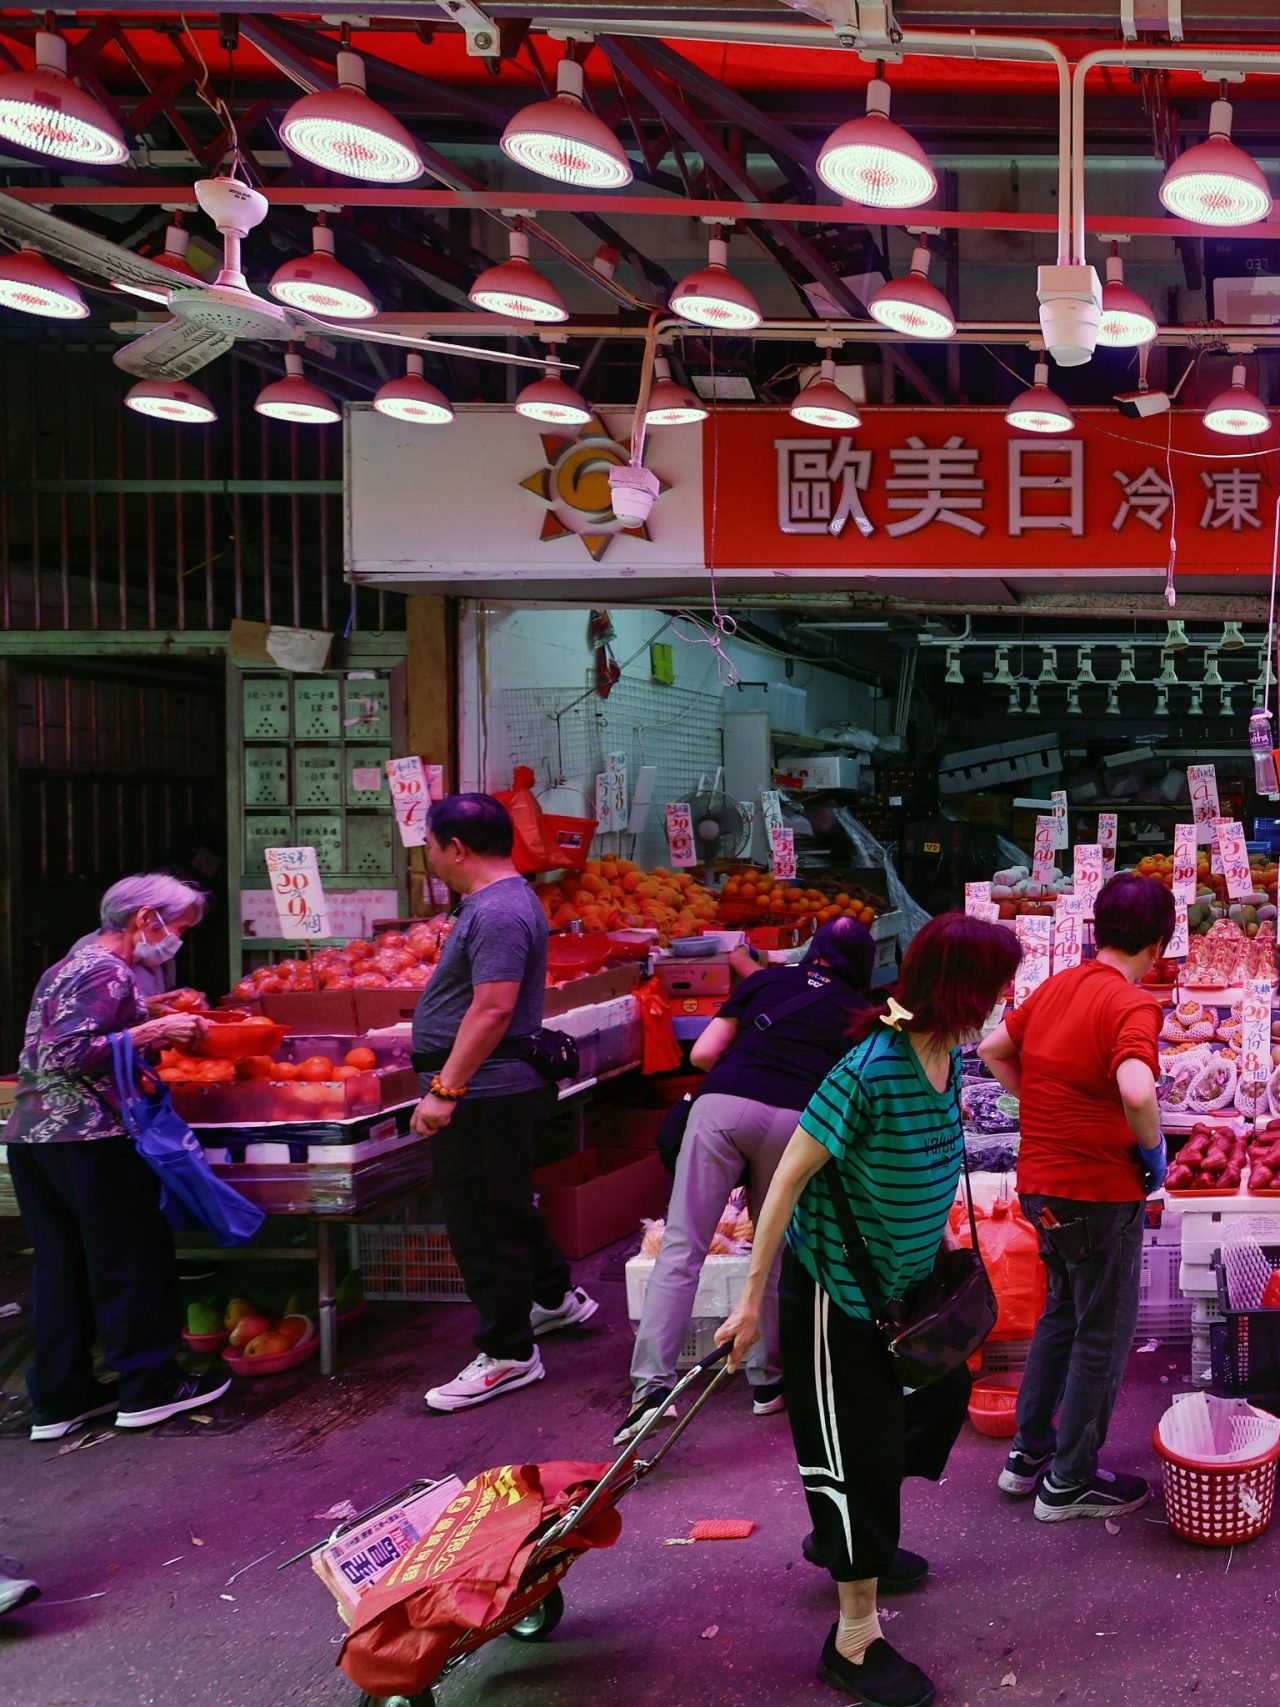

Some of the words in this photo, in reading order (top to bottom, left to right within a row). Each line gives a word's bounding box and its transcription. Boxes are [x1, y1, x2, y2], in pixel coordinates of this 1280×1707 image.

[774, 436, 1085, 538] 歐美日
[393, 779, 421, 800] 20
[1193, 784, 1213, 801] 4
[403, 801, 422, 827] 7
[669, 818, 689, 832] 20
[1174, 843, 1190, 860] 4
[1224, 841, 1240, 862] 2
[276, 872, 309, 894] 20
[1076, 870, 1099, 885] 20
[1174, 867, 1195, 882] 50
[288, 896, 307, 928] 9
[1057, 917, 1076, 938] 4
[1055, 942, 1080, 957] 40
[1245, 1005, 1268, 1021] 20
[1245, 1052, 1260, 1071] 8
[433, 1486, 497, 1576] 藥房有限公
